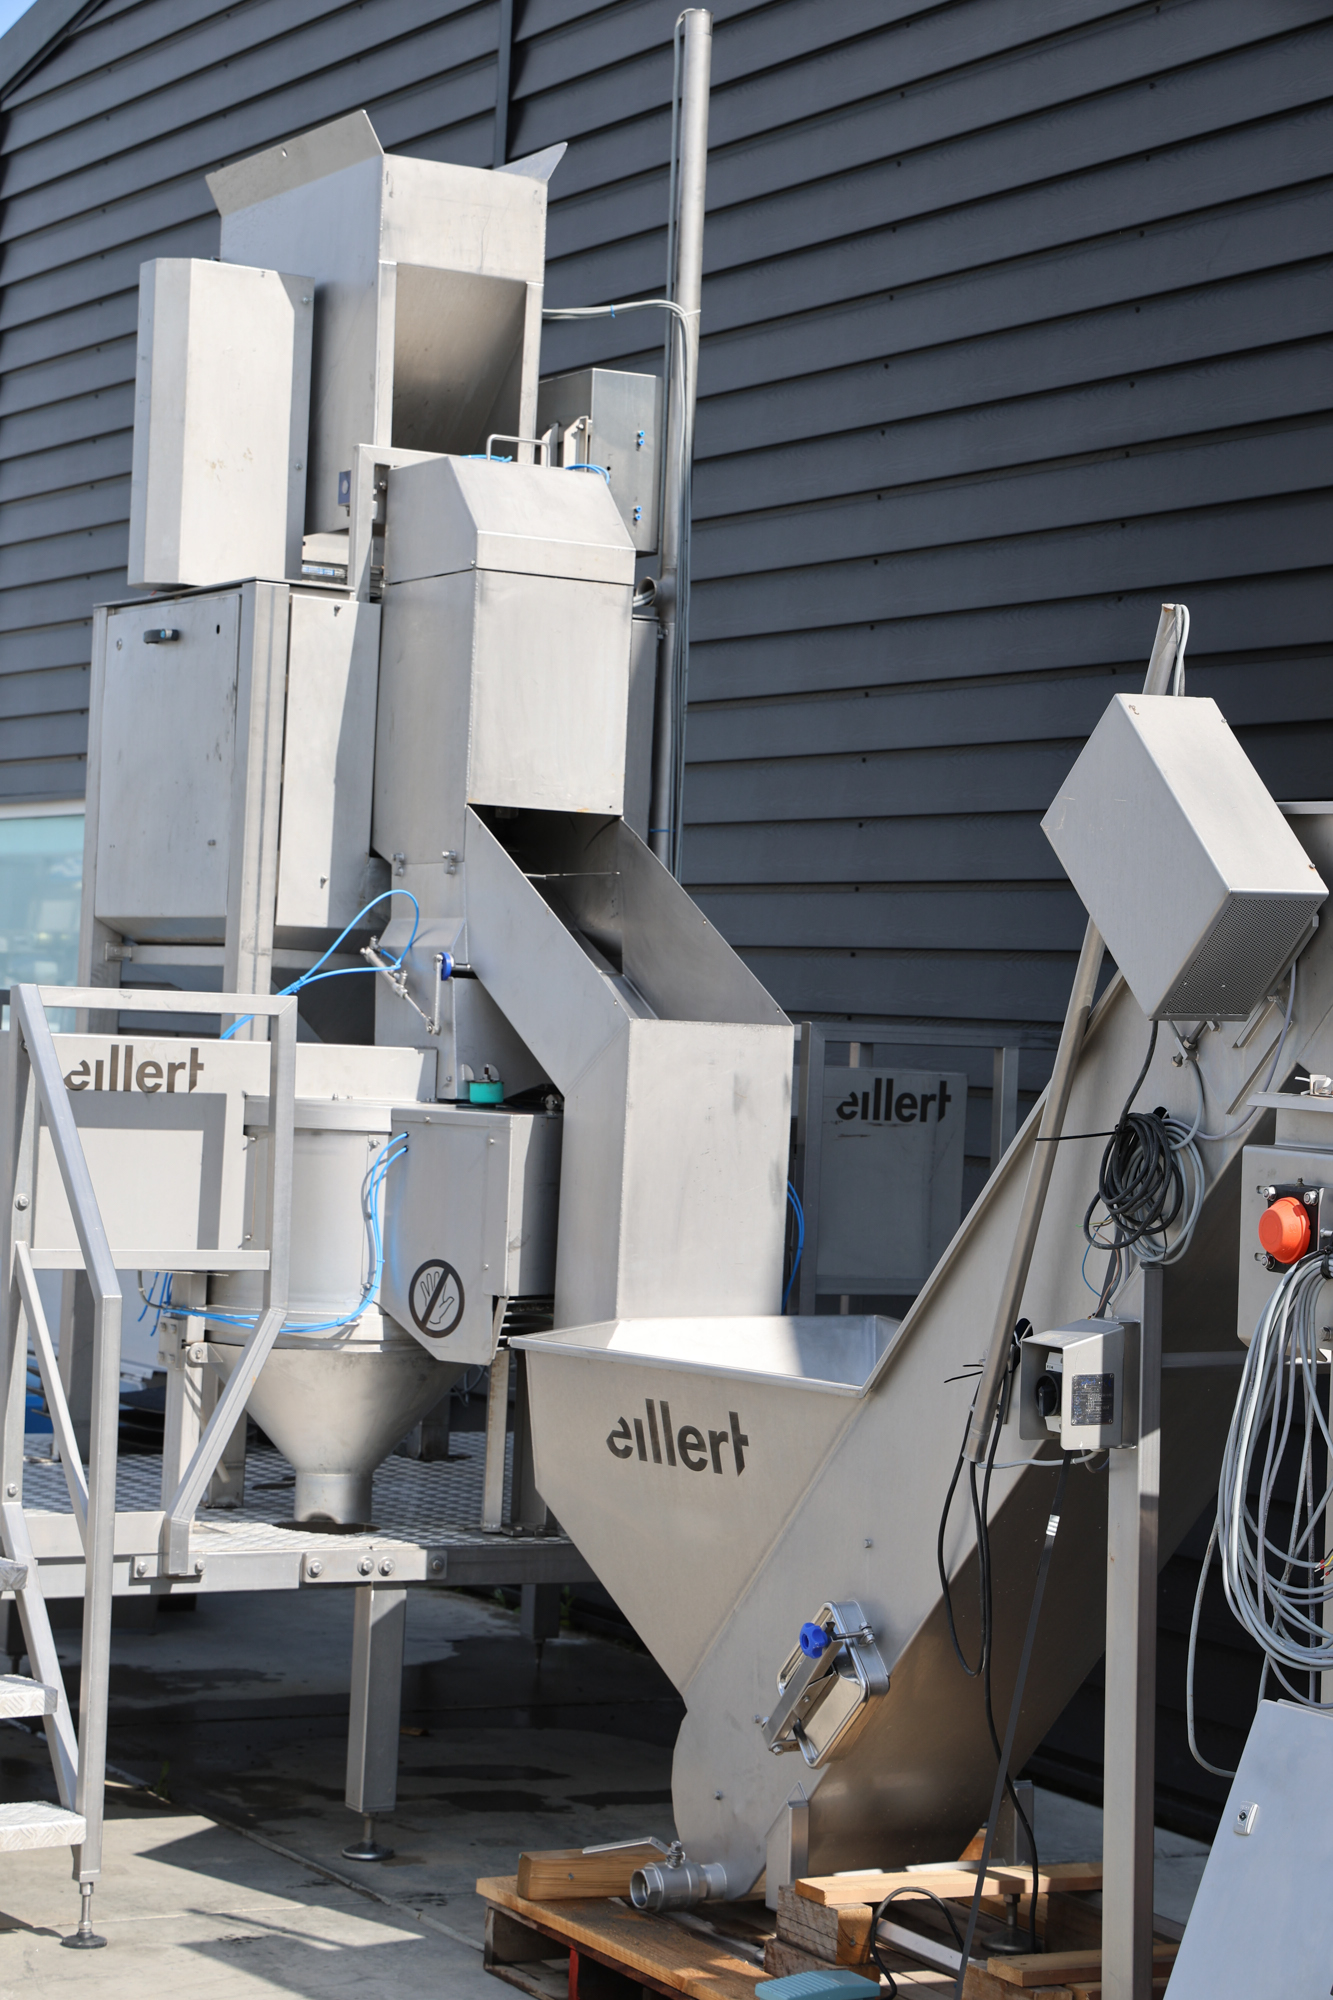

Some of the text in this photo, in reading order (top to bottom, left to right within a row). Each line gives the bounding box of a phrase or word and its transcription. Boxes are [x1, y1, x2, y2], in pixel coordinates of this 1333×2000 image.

[63, 1044, 204, 1093] eillert
[836, 1077, 951, 1123] eillert
[606, 1398, 749, 1477] eillert
